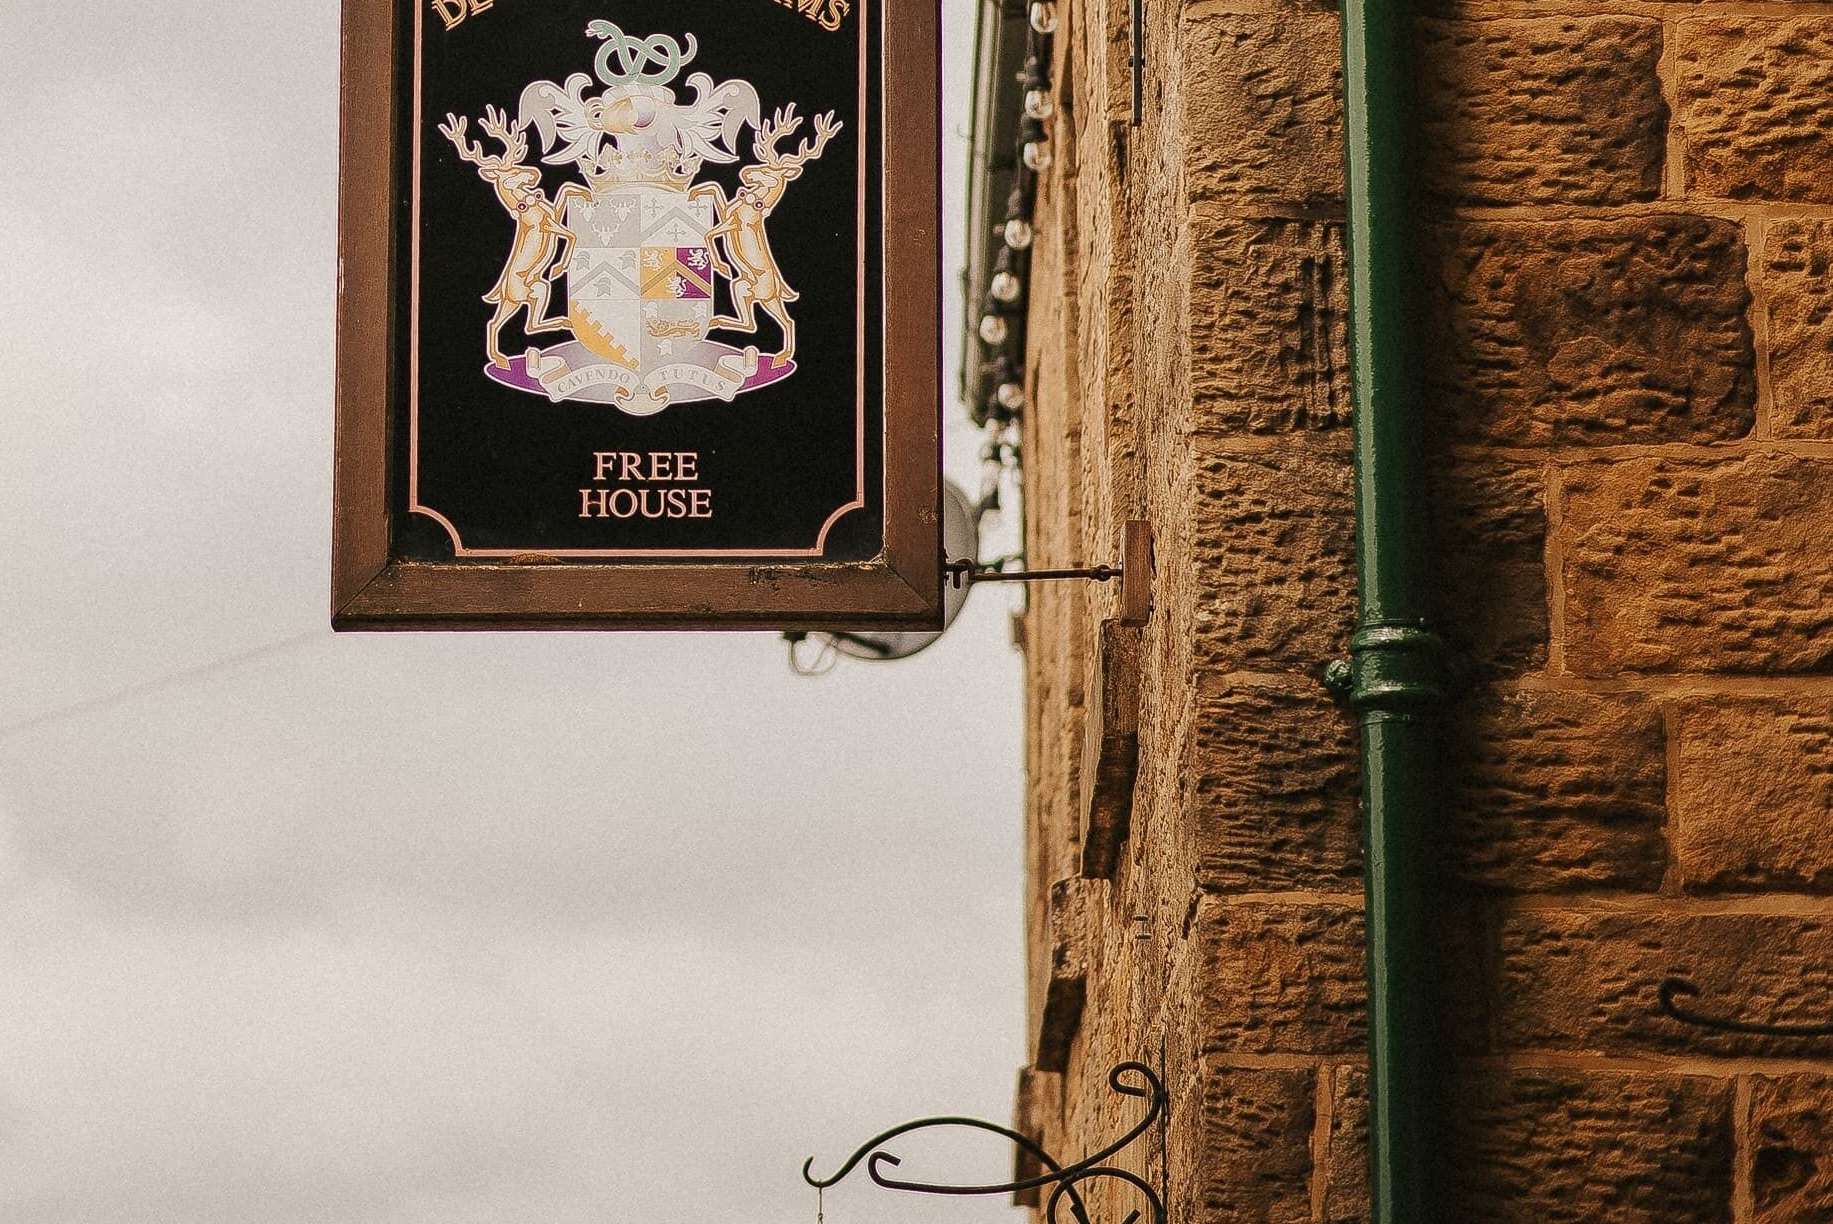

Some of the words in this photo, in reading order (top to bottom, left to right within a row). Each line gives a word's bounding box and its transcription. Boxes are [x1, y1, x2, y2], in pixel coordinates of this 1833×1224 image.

[557, 368, 631, 394] CAVENDO
[659, 368, 726, 392] TUTUS
[592, 451, 699, 481] FREE
[578, 488, 713, 518] HOUSE
